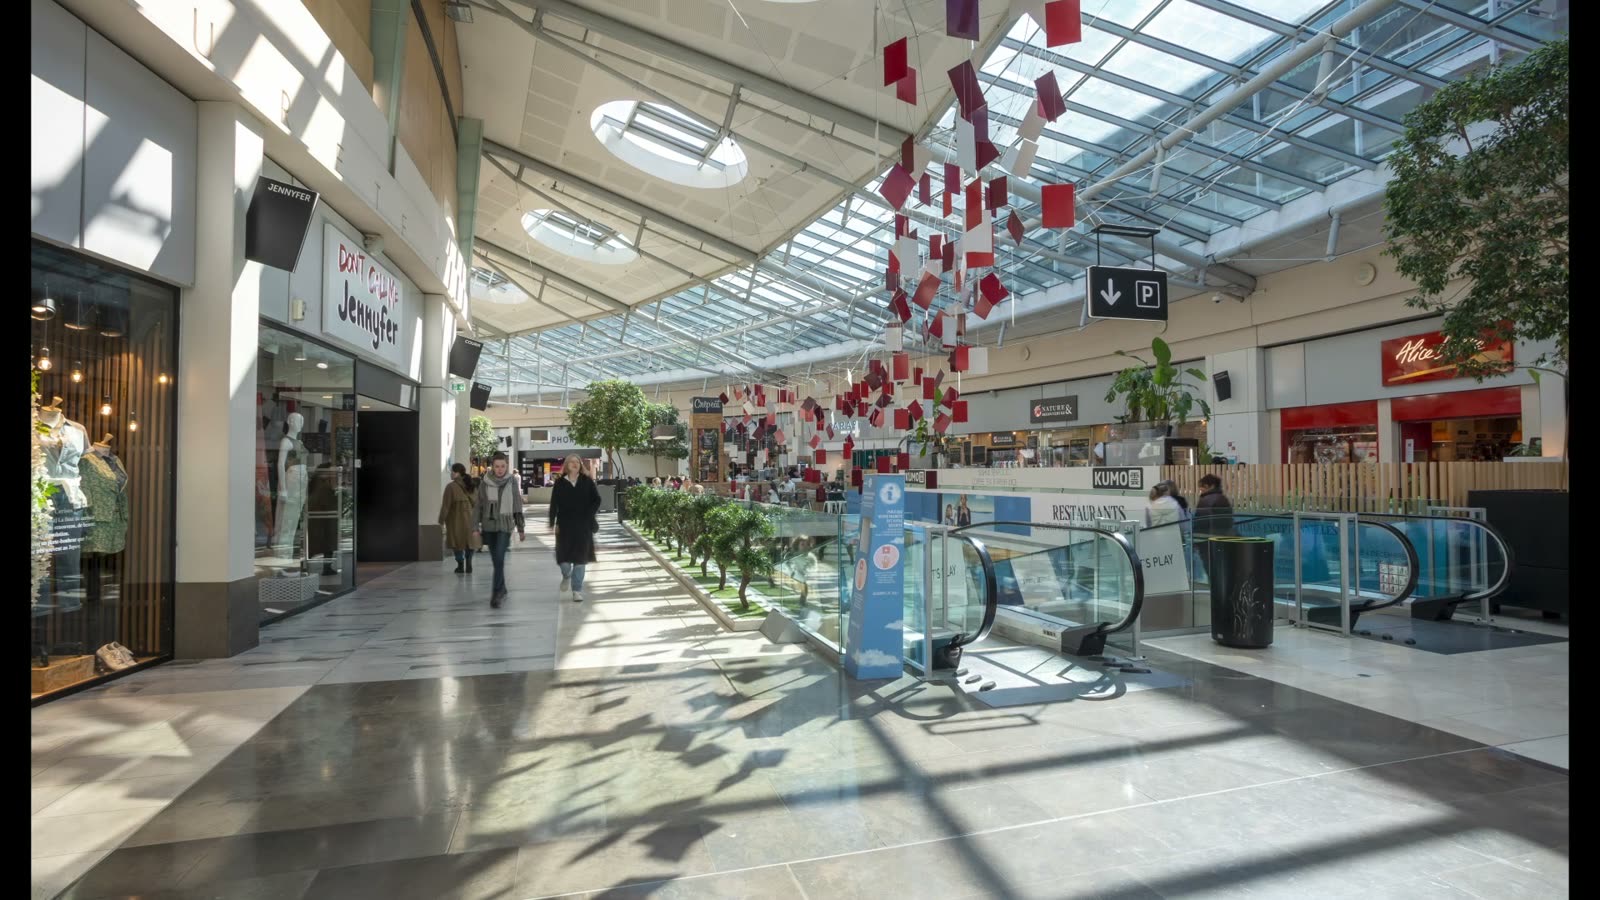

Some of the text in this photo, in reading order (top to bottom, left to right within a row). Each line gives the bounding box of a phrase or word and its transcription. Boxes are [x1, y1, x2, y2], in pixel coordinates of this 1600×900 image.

[267, 183, 312, 203] JENNYFER
[338, 243, 366, 282] DON'T
[367, 265, 389, 301] CALL
[338, 279, 399, 350] Jennyfer
[1395, 338, 1435, 365] Alice
[1041, 404, 1066, 412] NATURE
[1094, 471, 1128, 486] KUMO
[1052, 504, 1127, 521] RESTAURANTS
[1152, 553, 1173, 567] PLAY
